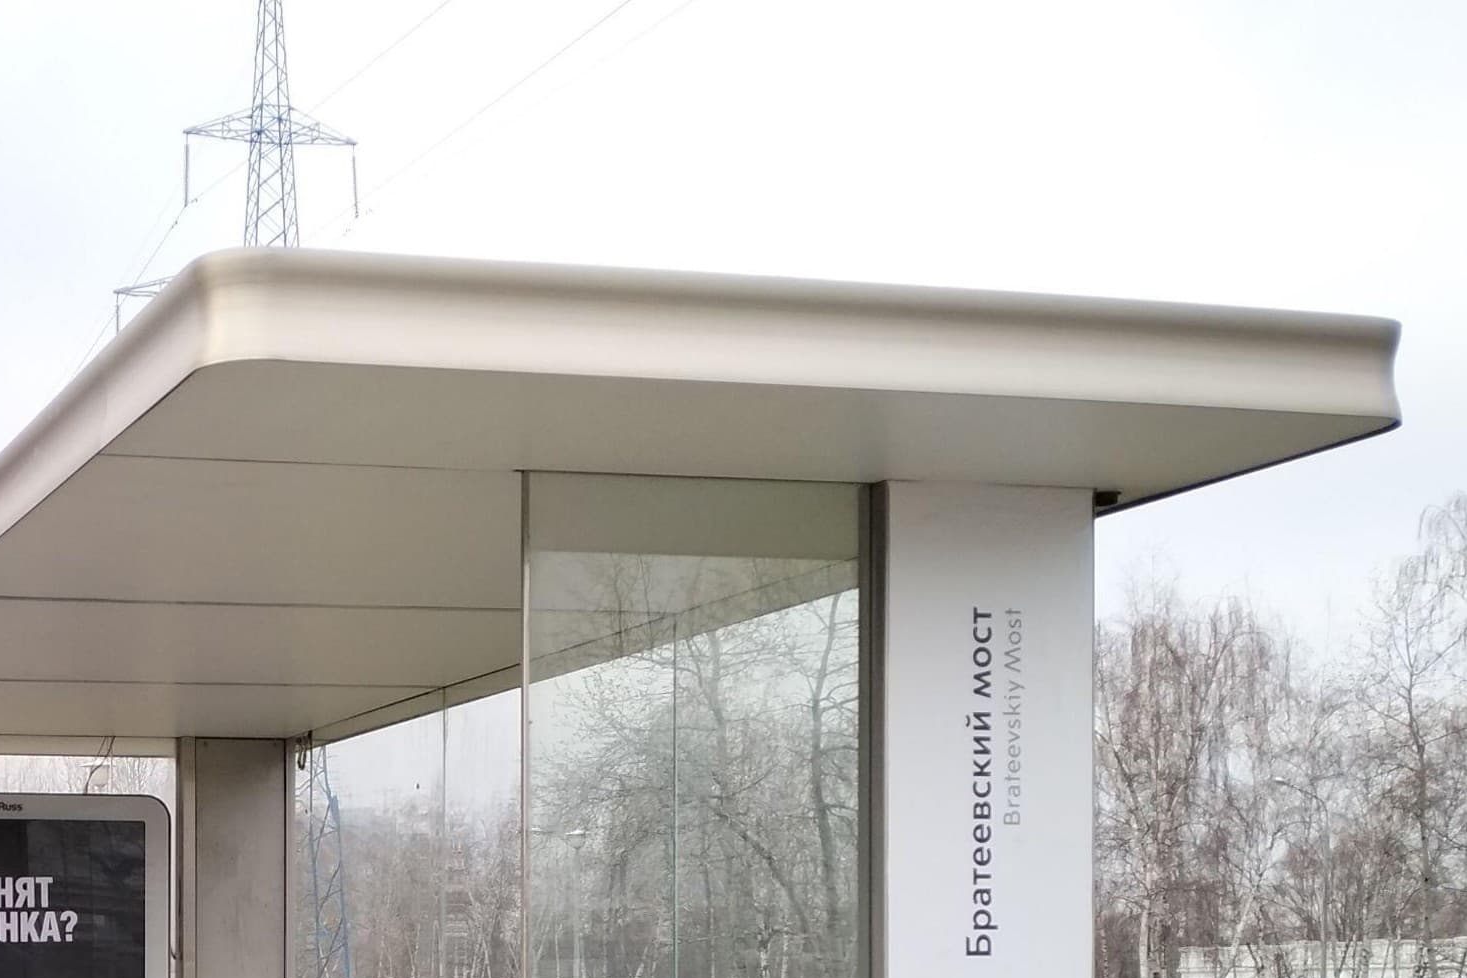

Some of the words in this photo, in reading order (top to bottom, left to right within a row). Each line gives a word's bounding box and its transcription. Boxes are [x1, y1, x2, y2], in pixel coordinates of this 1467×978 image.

[1003, 607, 1023, 674] Most
[1003, 680, 1026, 826] Brateevskiy
[965, 710, 998, 957] Братеевский
